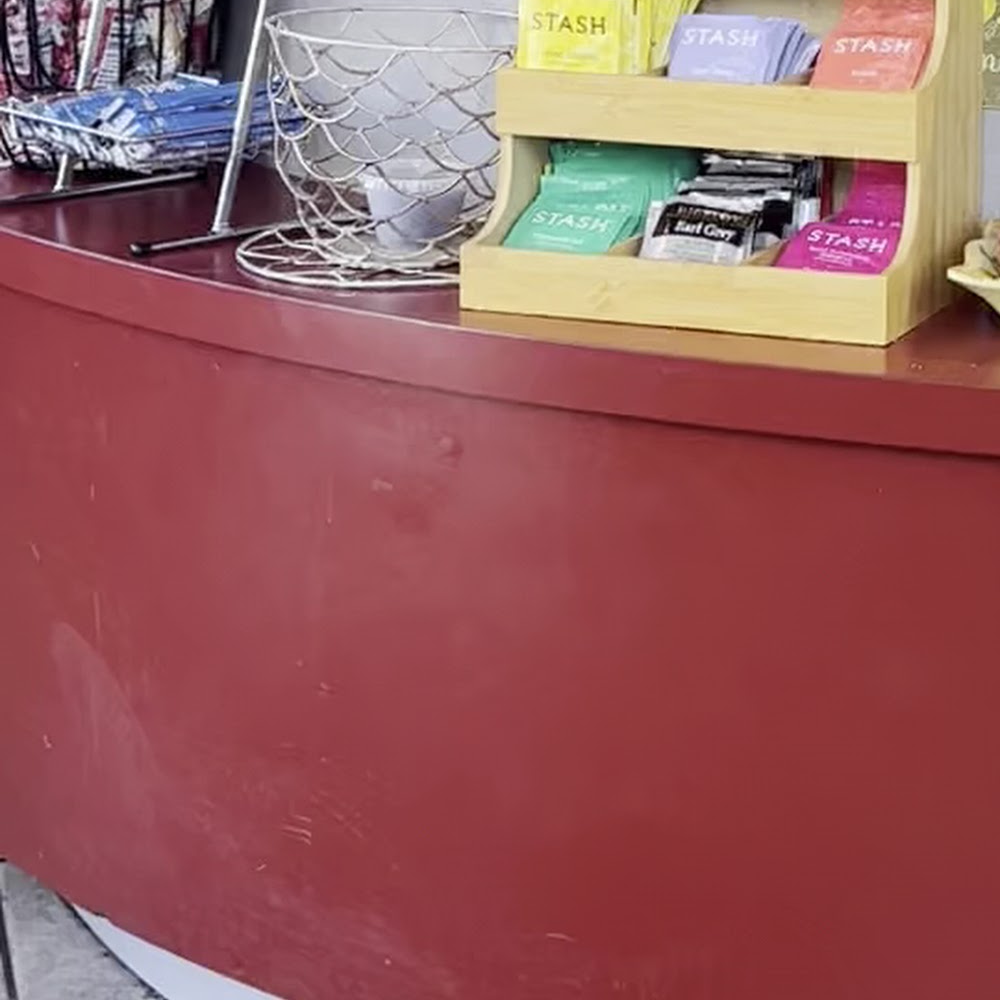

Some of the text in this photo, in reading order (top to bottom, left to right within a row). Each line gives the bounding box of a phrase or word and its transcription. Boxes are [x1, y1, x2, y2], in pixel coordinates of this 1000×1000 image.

[531, 12, 606, 36] STASH
[681, 27, 760, 47] STASH
[833, 37, 913, 56] STASH
[530, 210, 609, 233] STASH
[674, 219, 738, 242] Earl Grey
[806, 229, 888, 253] STASH
